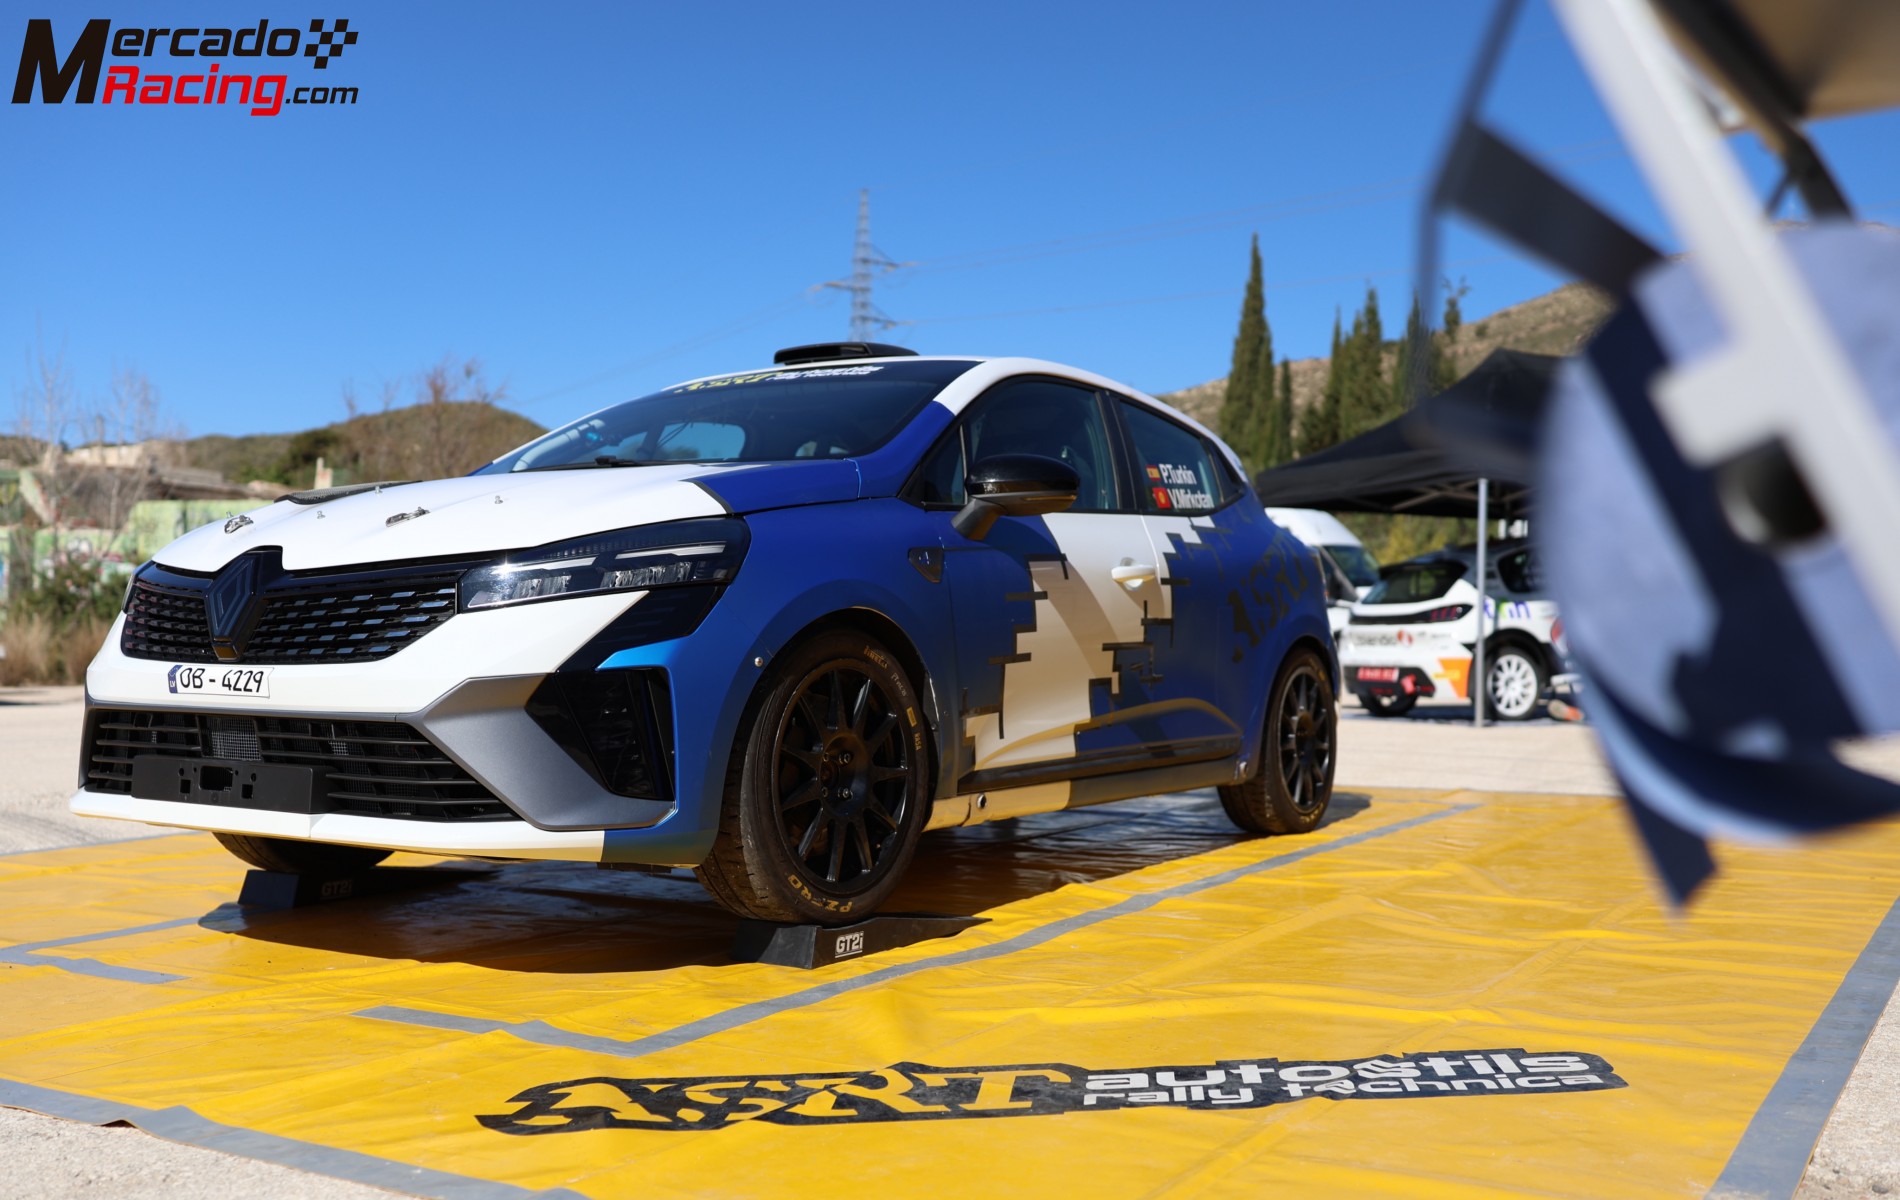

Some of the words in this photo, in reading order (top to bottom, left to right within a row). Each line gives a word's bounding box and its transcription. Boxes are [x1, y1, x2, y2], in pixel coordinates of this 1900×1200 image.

[1158, 463, 1197, 485] P.Turkin
[169, 680, 176, 688] LV
[180, 667, 206, 689] OB
[222, 669, 264, 693] 4229
[835, 931, 864, 954] GT2i
[513, 1068, 1072, 1125] ASRT
[1083, 1085, 1254, 1105] rally
[1281, 1072, 1604, 1097] technica
